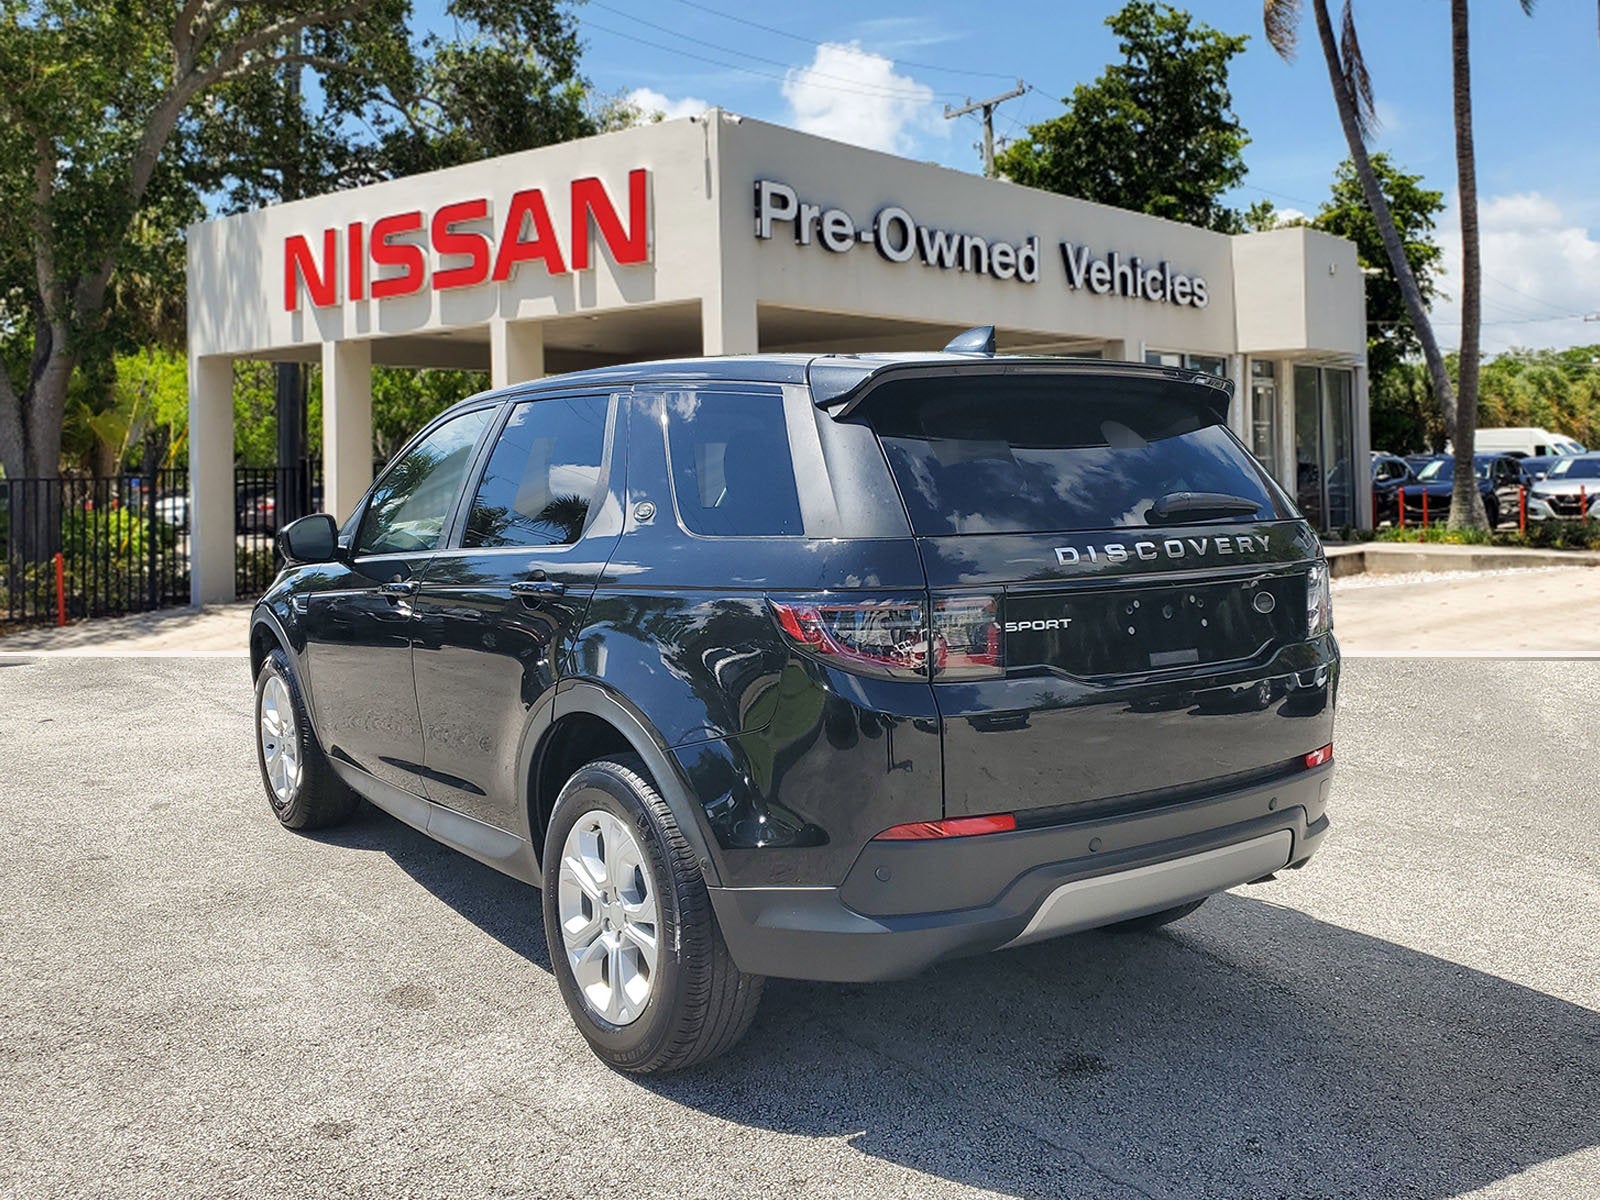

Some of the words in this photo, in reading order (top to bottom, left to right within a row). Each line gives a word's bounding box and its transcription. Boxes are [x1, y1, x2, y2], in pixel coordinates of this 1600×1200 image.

[285, 168, 650, 312] NISSAN
[754, 180, 1039, 283] Pre-Owned
[1060, 241, 1208, 308] Vehicles
[1054, 534, 1270, 566] DISCOVERY
[1005, 617, 1072, 633] SPORT
